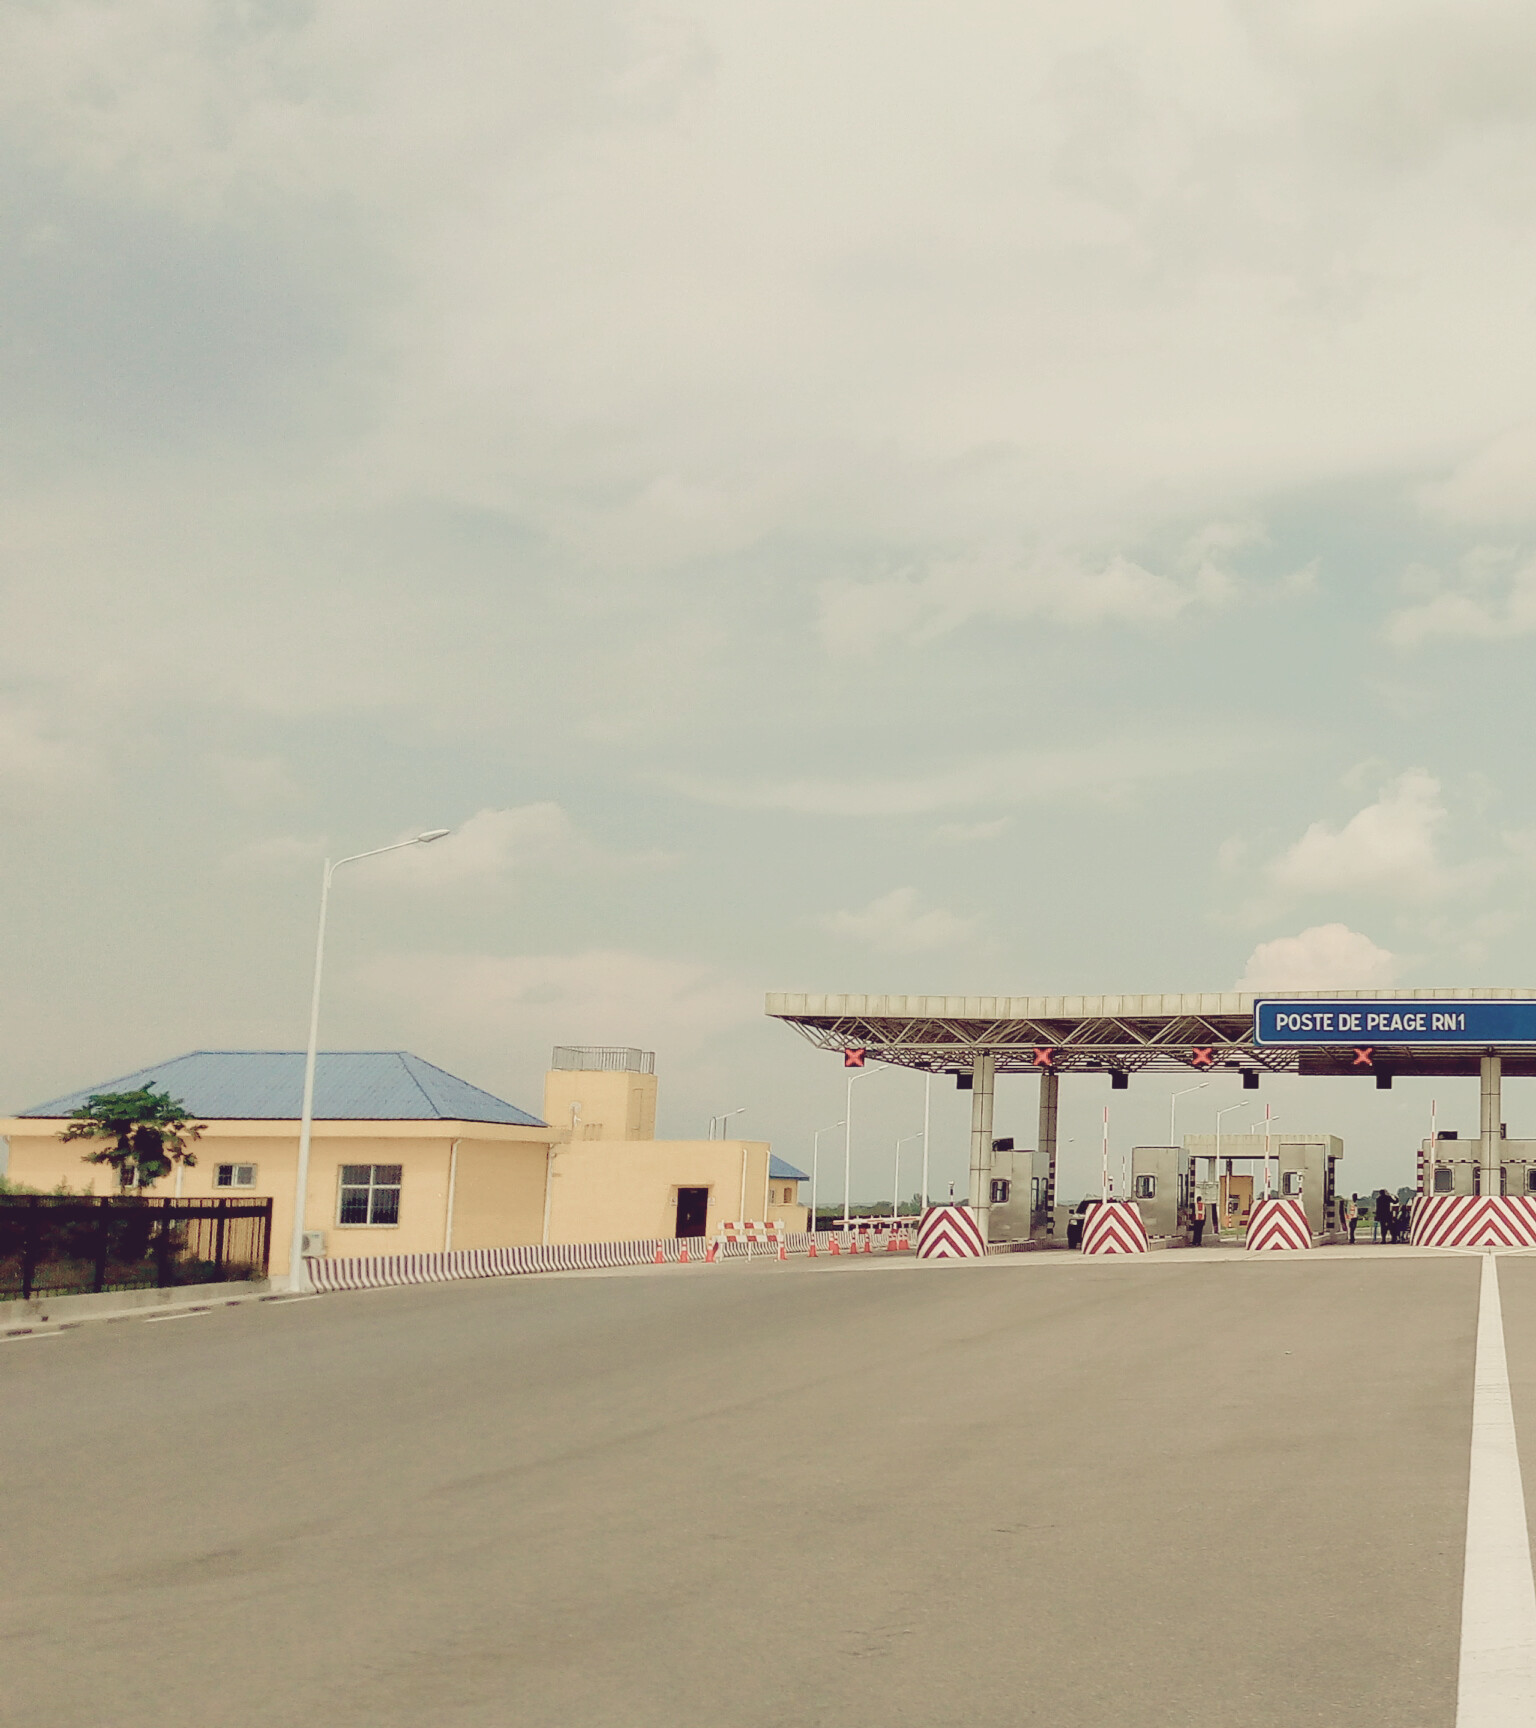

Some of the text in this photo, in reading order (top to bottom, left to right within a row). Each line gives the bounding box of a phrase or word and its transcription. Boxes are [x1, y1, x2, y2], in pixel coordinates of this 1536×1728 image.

[1276, 1013, 1334, 1031] POSTE
[1338, 1013, 1362, 1031] DE
[1366, 1013, 1427, 1031] PEAGE
[1431, 1013, 1465, 1031] RN1
